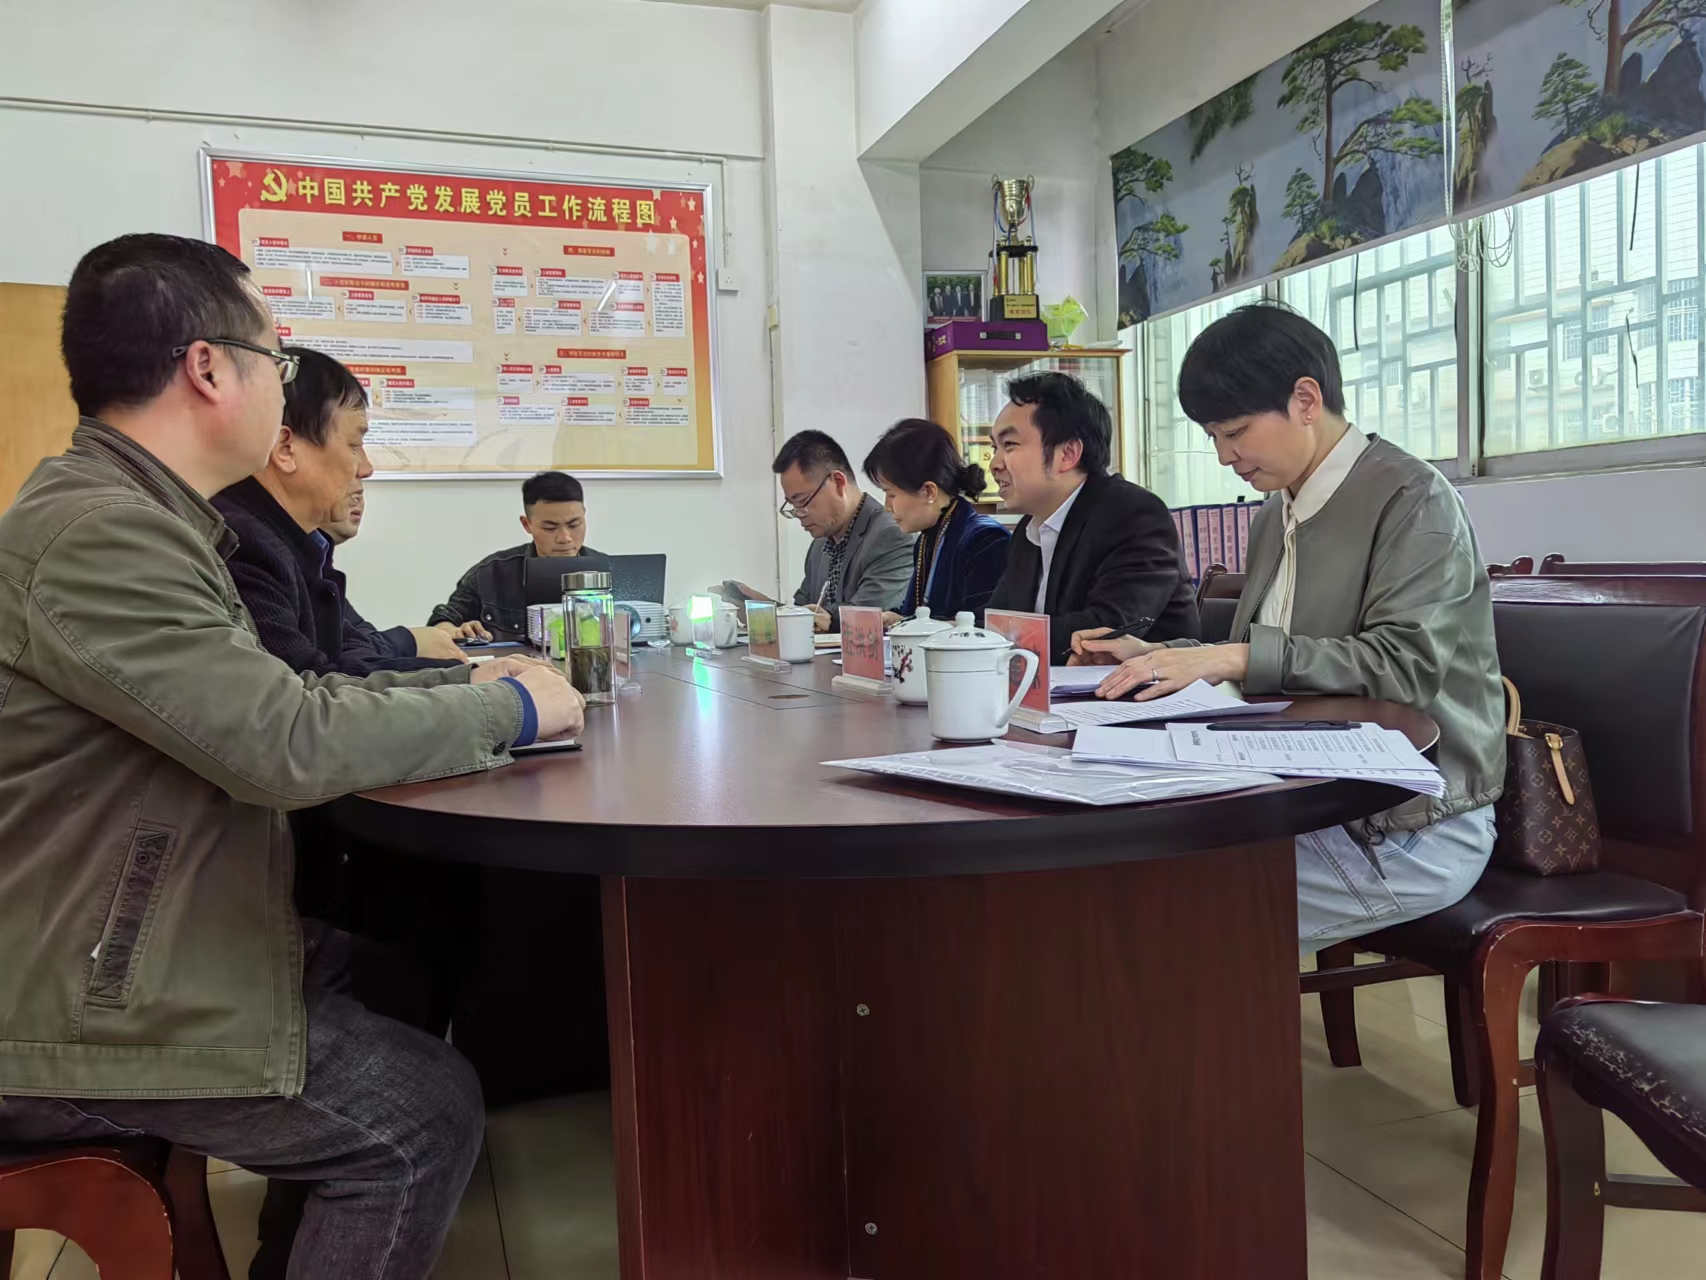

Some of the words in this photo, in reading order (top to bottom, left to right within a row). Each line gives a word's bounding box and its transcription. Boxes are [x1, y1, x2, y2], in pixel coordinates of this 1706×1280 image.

[298, 176, 656, 225] 中国共产党发展党员工作流程图
